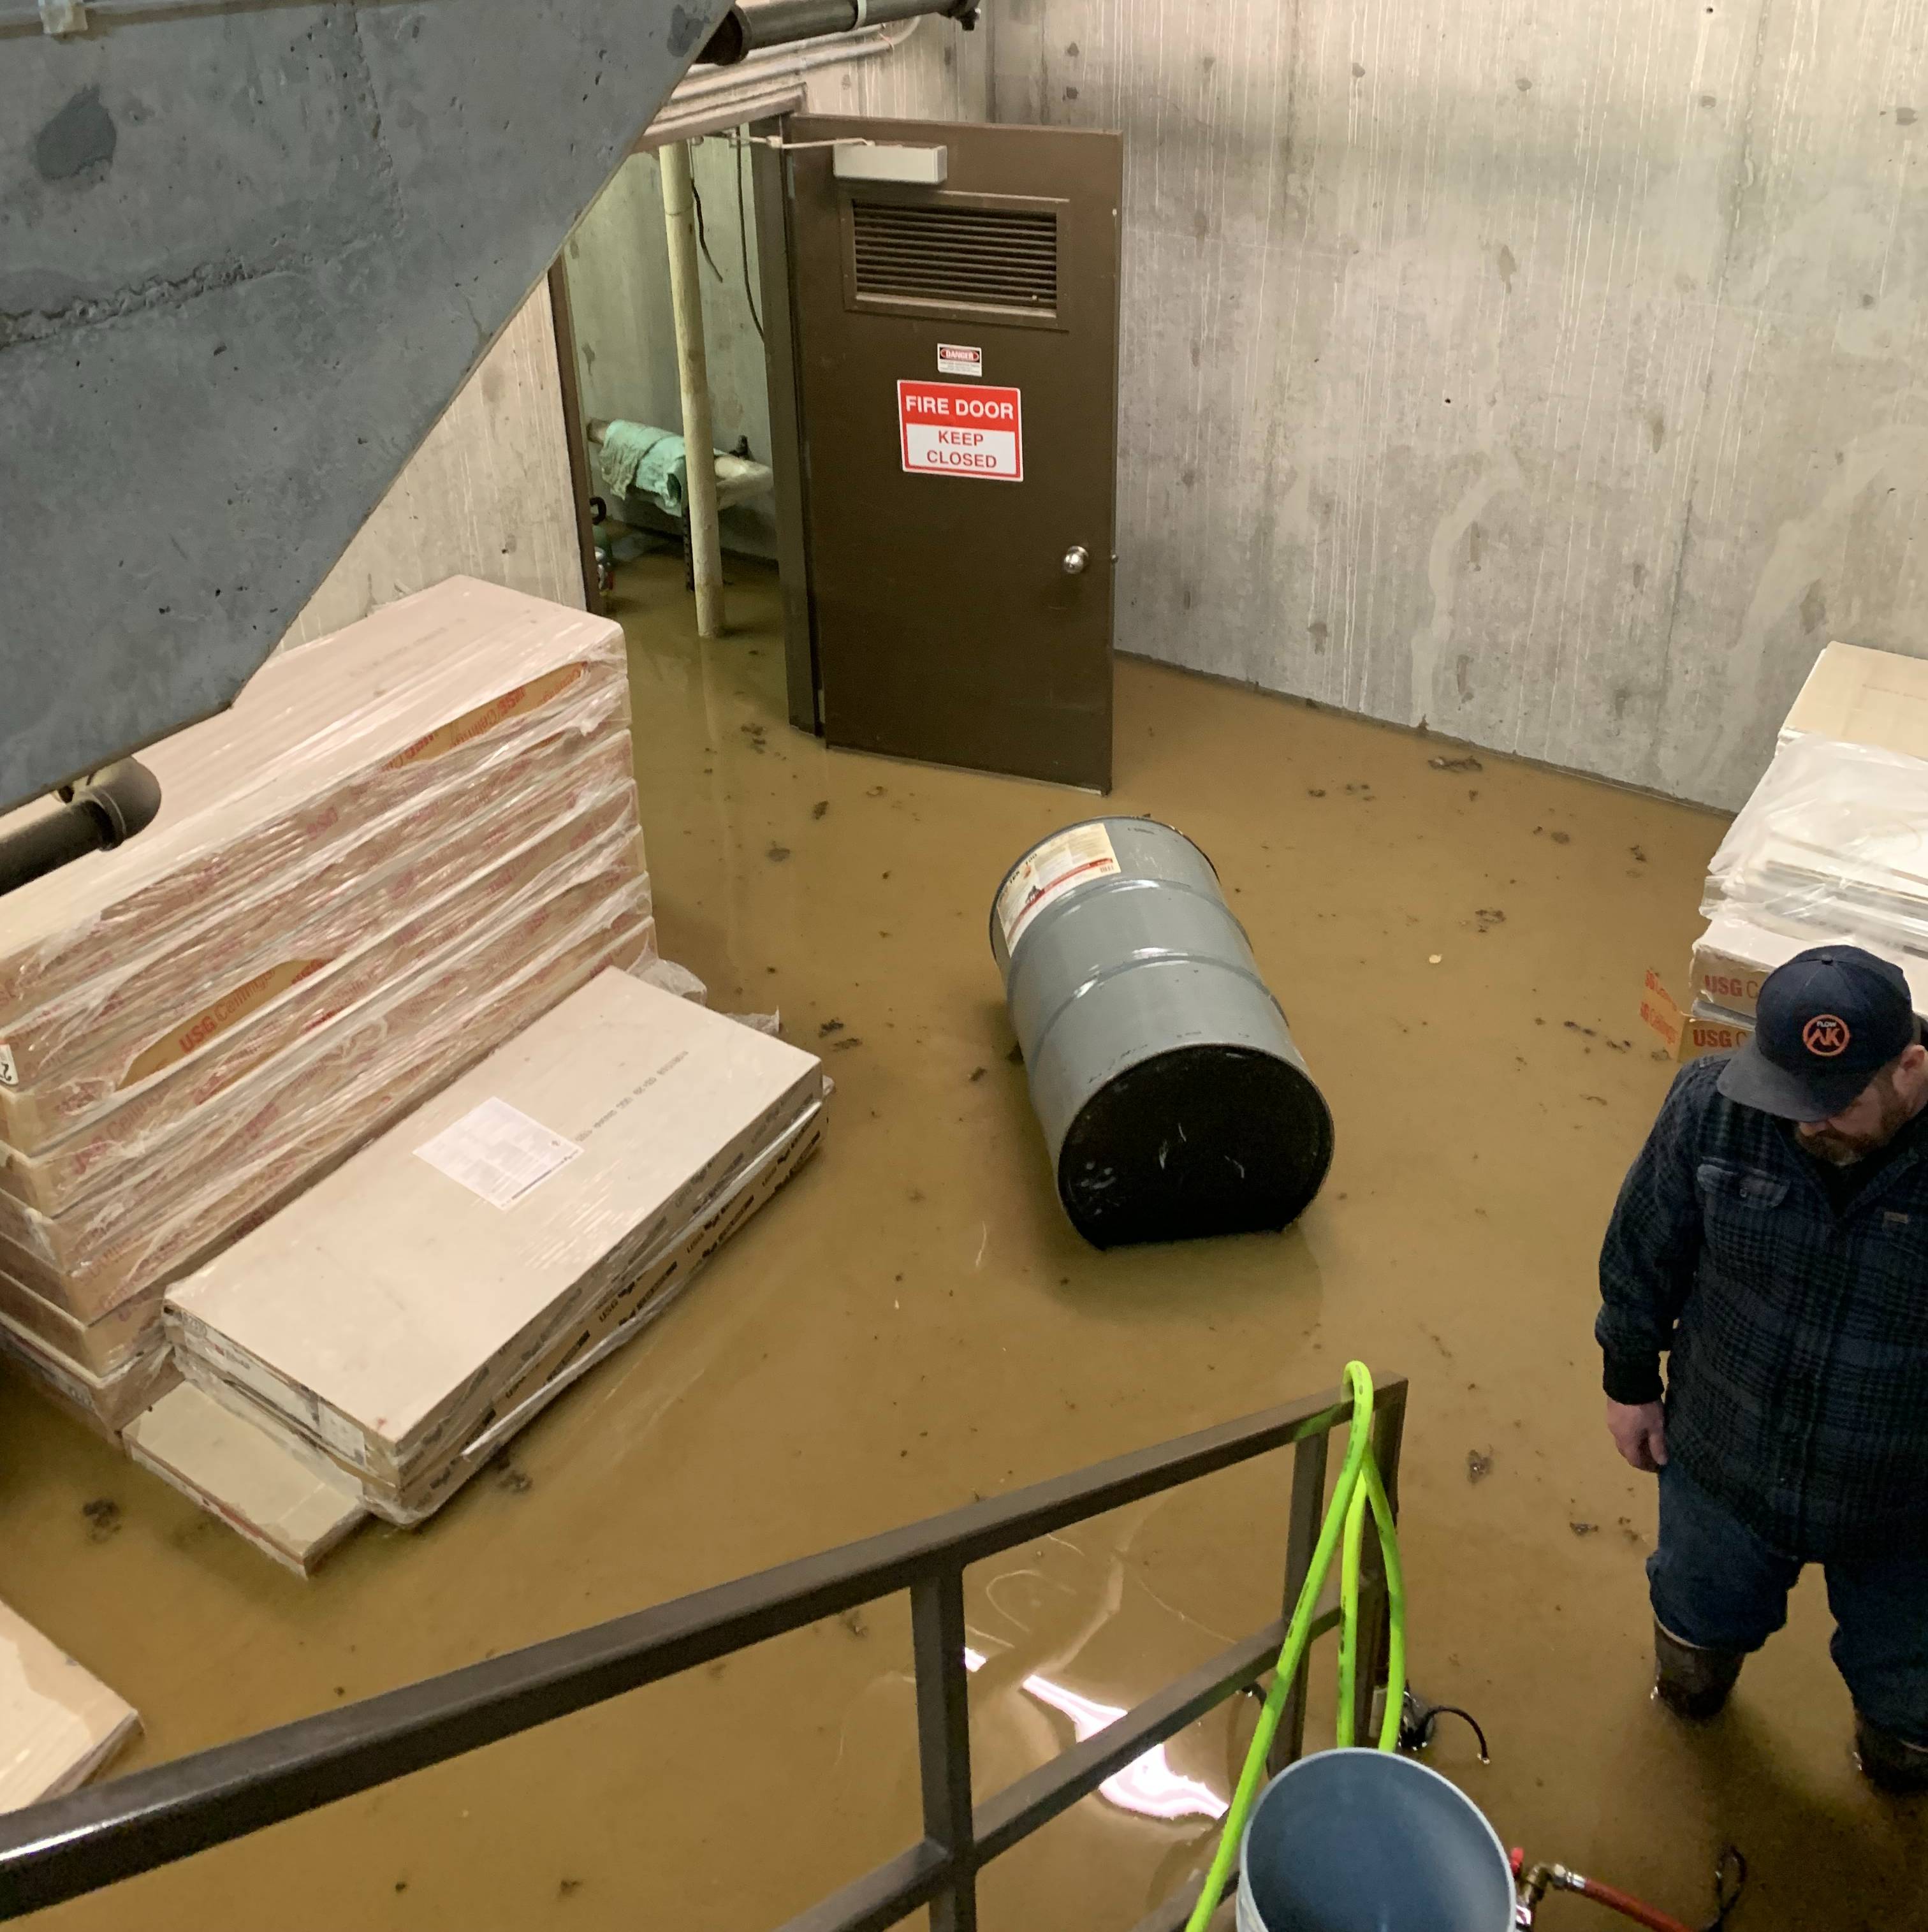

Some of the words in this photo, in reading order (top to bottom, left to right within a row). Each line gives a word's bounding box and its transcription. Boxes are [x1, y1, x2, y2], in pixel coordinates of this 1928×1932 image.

[946, 349, 974, 361] DANGER
[905, 395, 949, 414] FIRE
[955, 399, 1014, 420] DOOR
[938, 430, 984, 446] KEEP
[926, 450, 997, 469] CLOSED
[1704, 974, 1743, 997] USG
[179, 1015, 215, 1053] USG
[1693, 1028, 1732, 1048] USG
